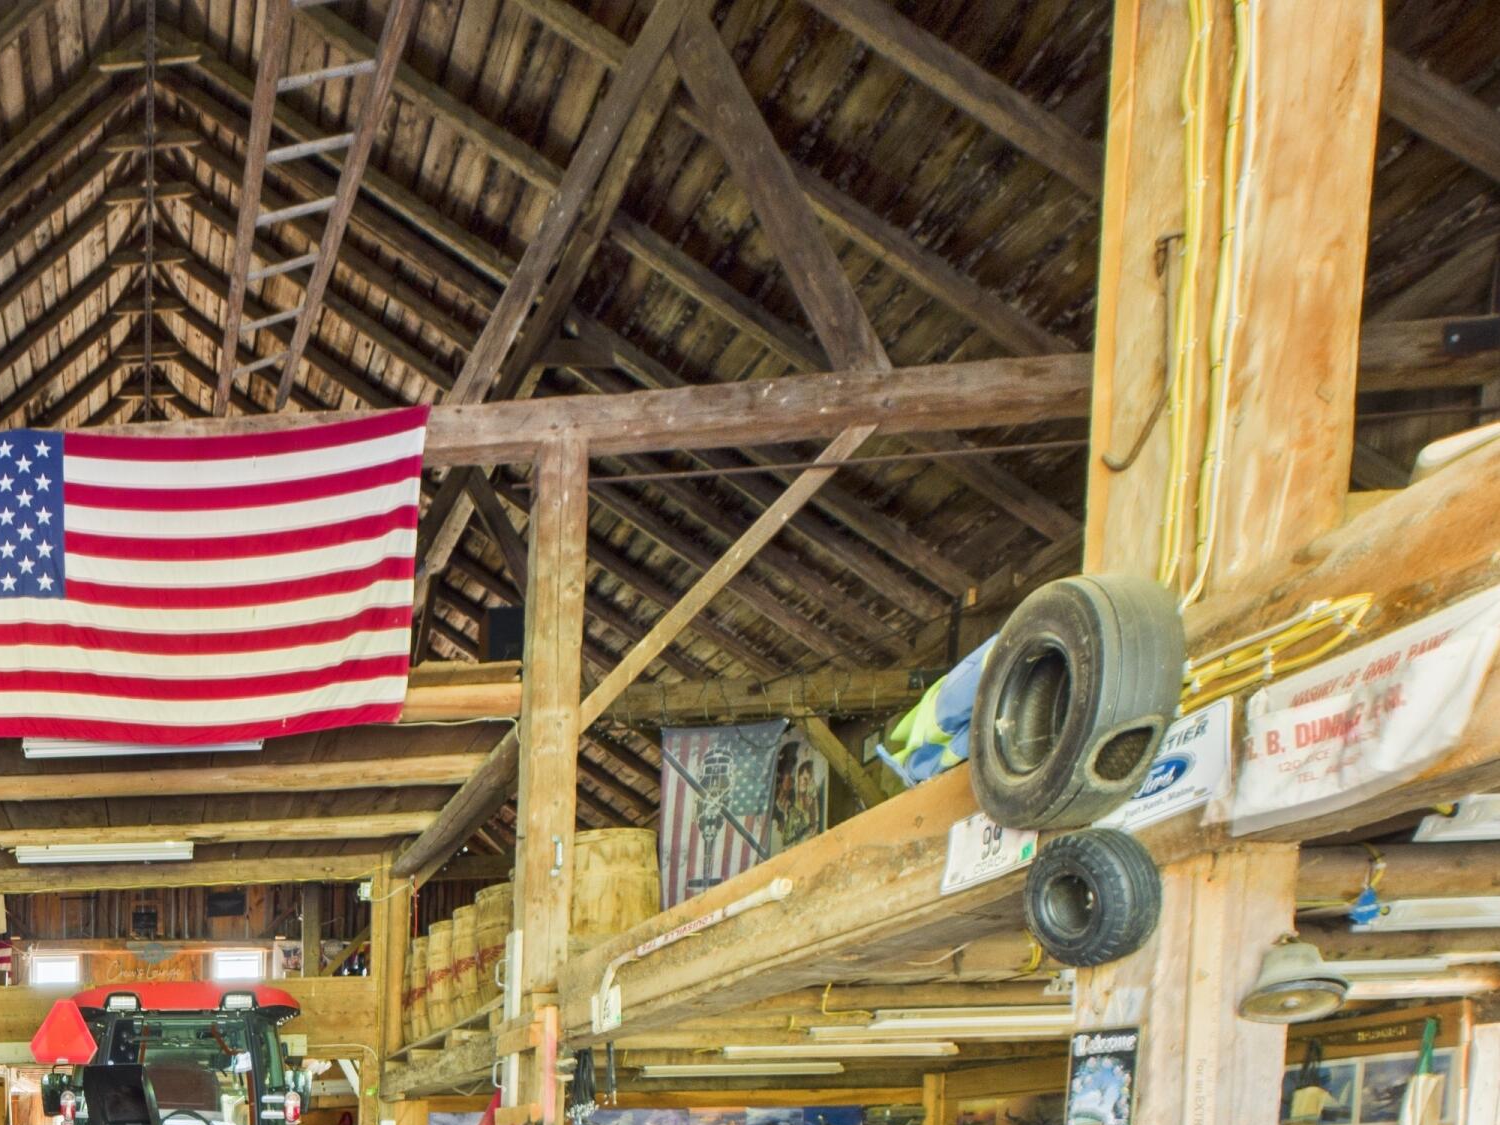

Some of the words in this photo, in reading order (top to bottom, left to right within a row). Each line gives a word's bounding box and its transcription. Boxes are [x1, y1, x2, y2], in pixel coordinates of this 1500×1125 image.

[1134, 763, 1177, 798] Ford
[981, 824, 1003, 860] 99
[1073, 1034, 1137, 1056] Welcome
